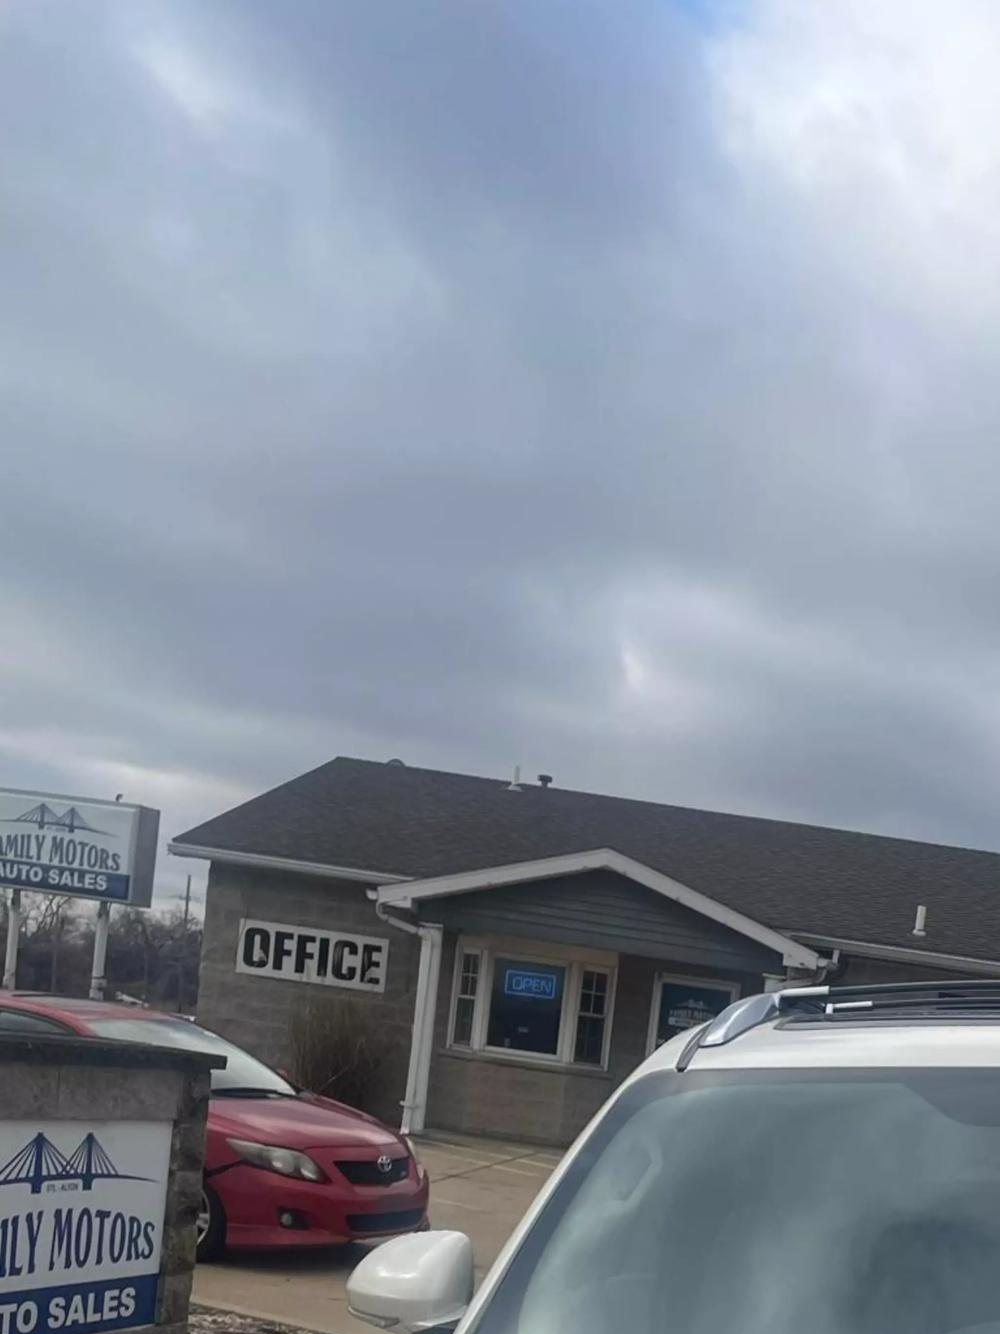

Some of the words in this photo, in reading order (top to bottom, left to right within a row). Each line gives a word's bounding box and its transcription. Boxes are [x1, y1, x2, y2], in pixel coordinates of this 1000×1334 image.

[49, 836, 121, 872] MOTORS
[48, 869, 108, 891] SALES
[242, 926, 383, 985] OFFICE
[512, 975, 552, 993] OPEN
[48, 1207, 155, 1272] MOTORS
[47, 1287, 136, 1329] SALES
